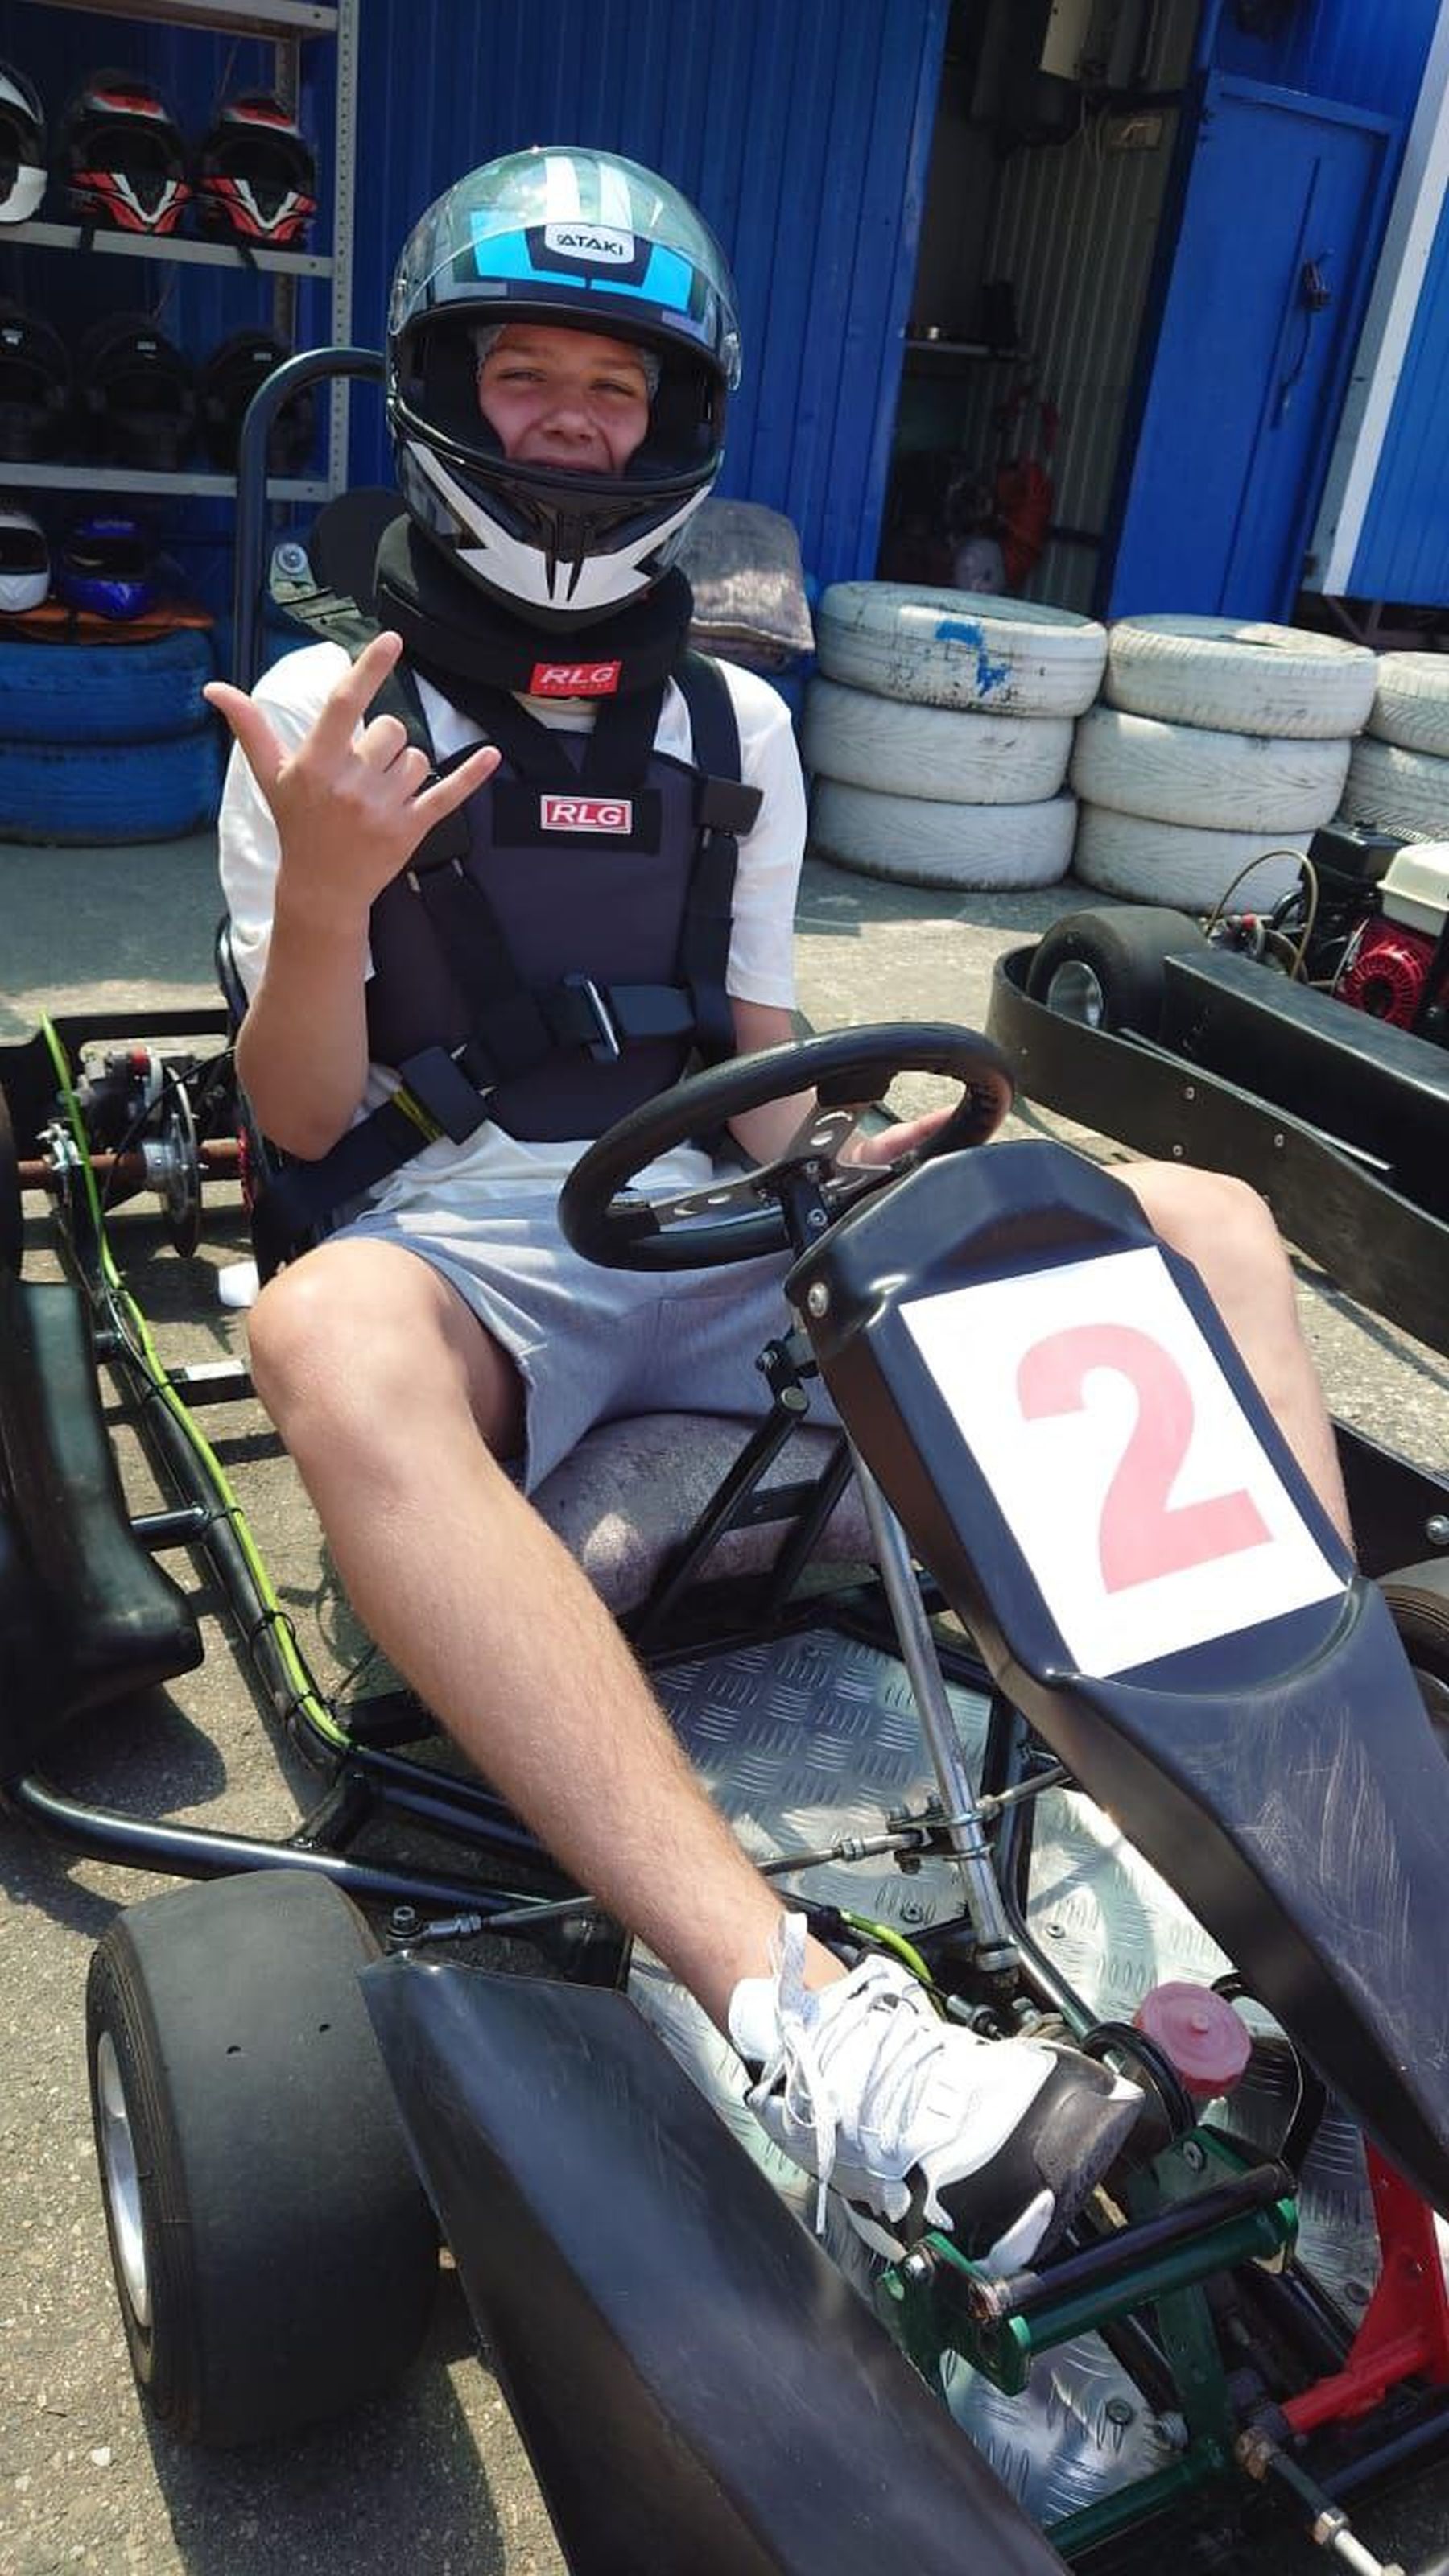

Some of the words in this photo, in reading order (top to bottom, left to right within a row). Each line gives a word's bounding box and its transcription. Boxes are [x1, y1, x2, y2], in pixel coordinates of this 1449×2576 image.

[558, 233, 624, 256] ATAKI
[539, 667, 615, 685] RLG
[550, 803, 622, 825] RLG
[1016, 1323, 1274, 1595] 2
